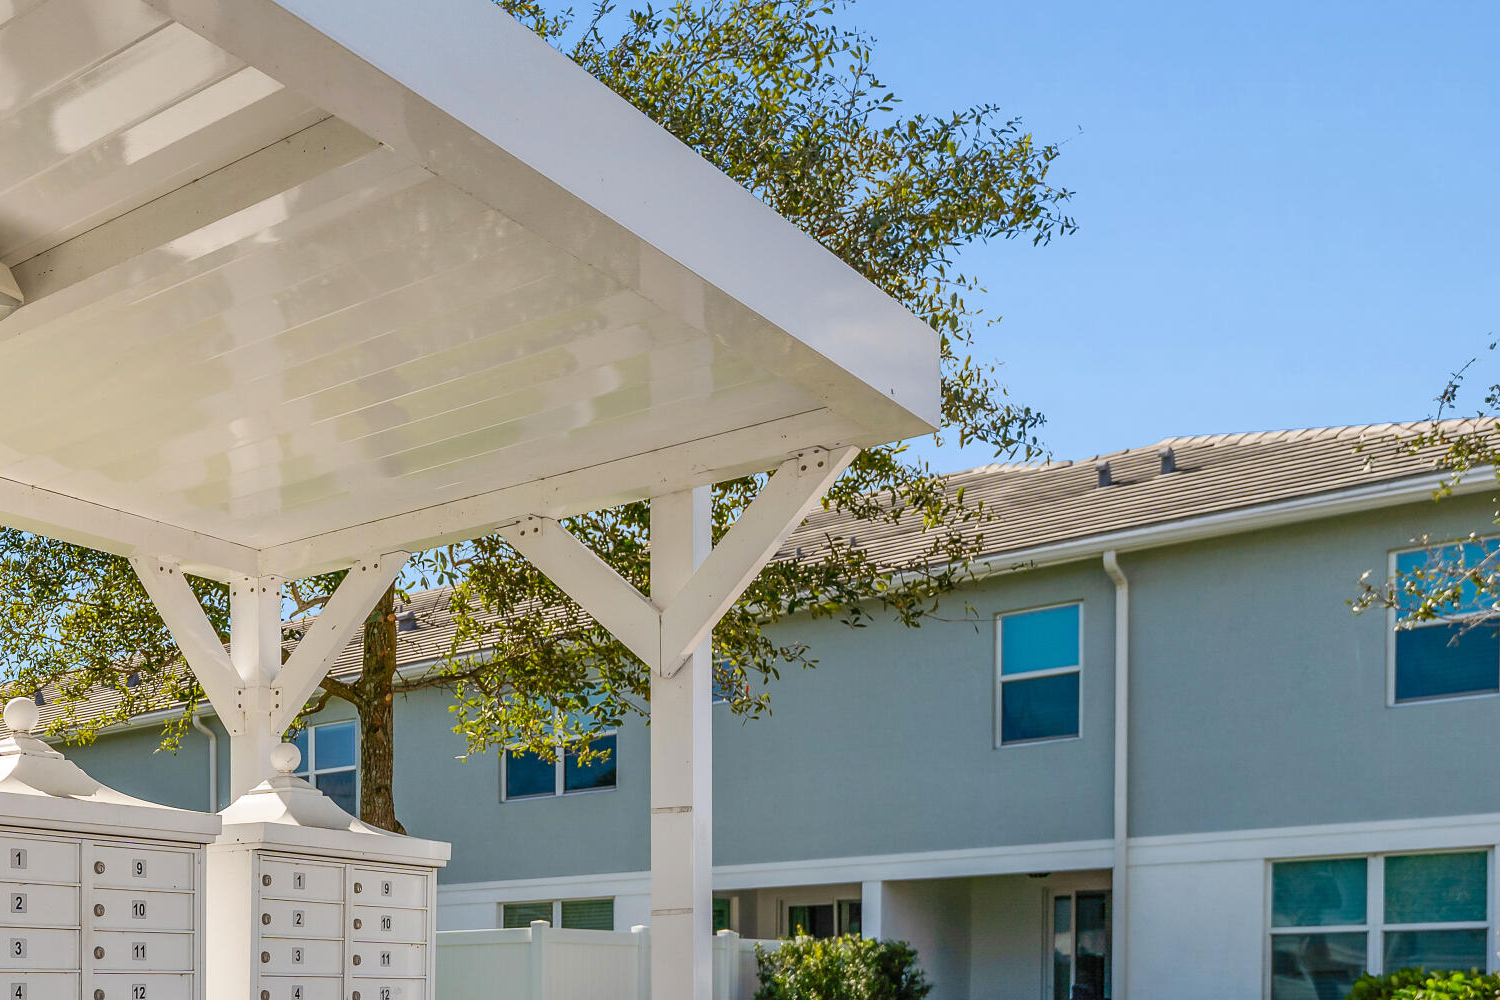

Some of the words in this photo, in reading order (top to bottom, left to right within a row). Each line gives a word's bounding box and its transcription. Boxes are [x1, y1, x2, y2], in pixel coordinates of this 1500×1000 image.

[15, 851, 21, 866] 1
[136, 862, 143, 875] 9
[15, 896, 23, 910] 2
[133, 903, 145, 917] 10
[382, 917, 391, 930] 10
[14, 941, 22, 956] 3
[134, 944, 145, 958] 11
[381, 953, 390, 965] 11
[15, 985, 23, 1000] 4
[133, 986, 146, 1000] 12
[380, 989, 390, 1000] 12
